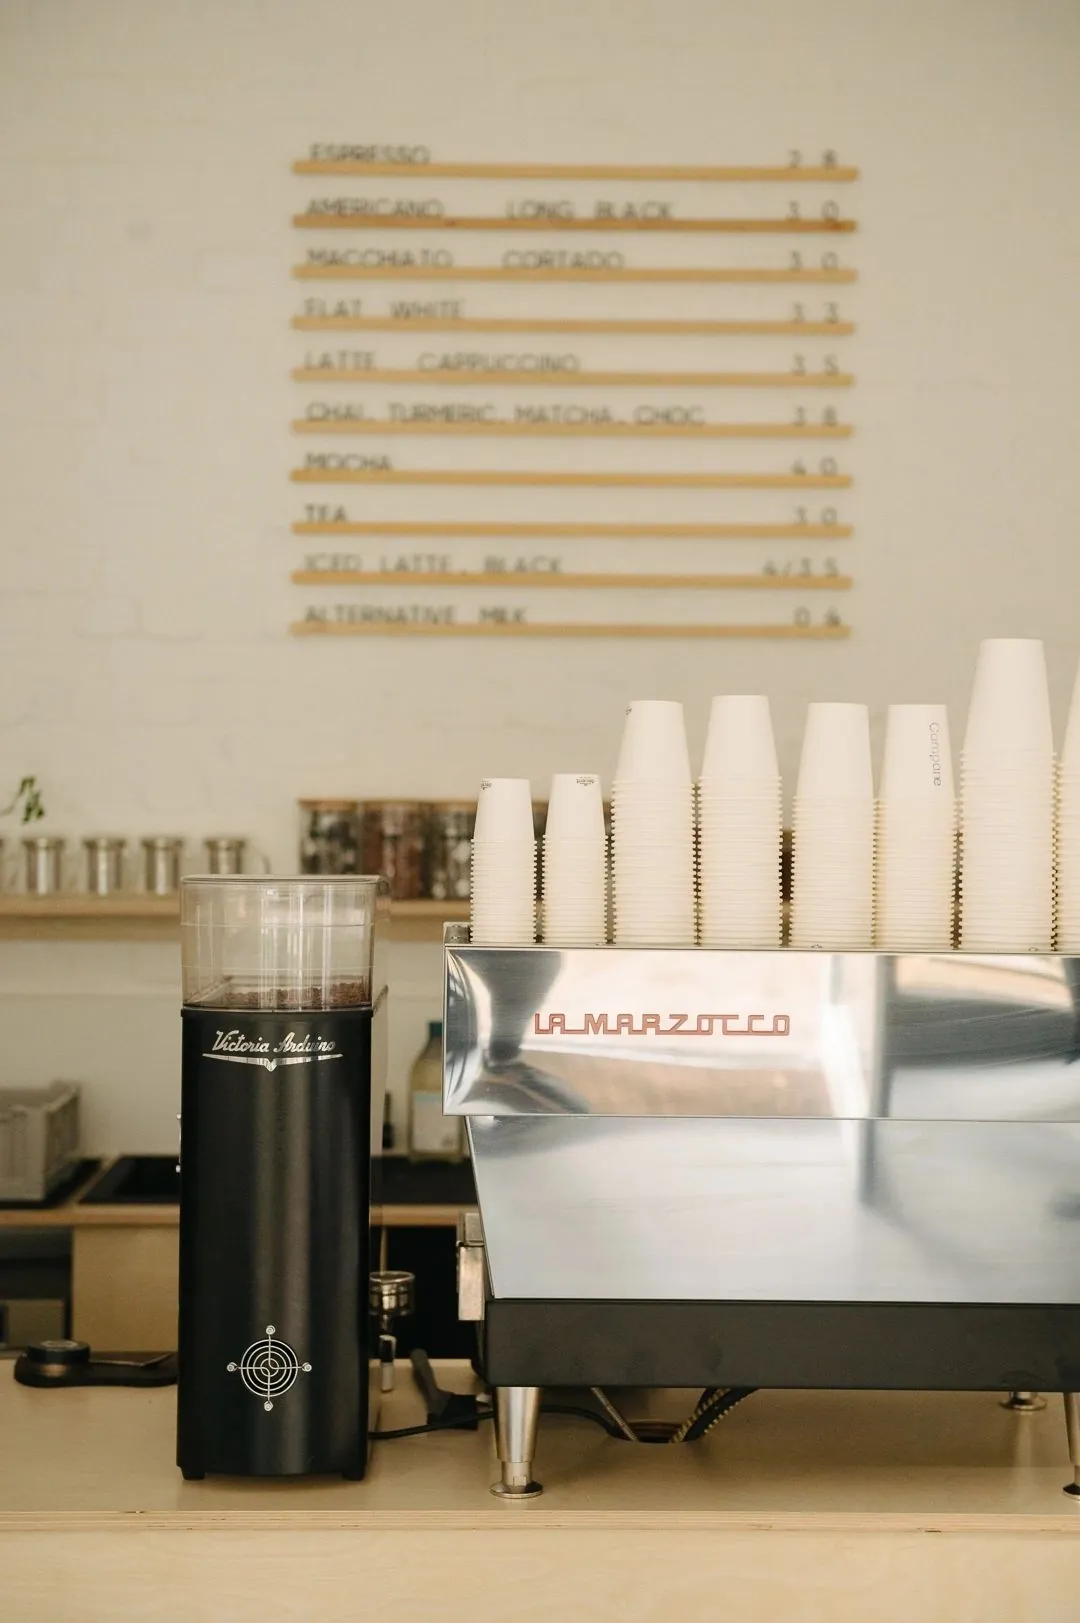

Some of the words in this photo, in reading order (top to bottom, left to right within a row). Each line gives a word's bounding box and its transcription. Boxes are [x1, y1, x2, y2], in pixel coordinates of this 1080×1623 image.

[310, 144, 430, 164] ESPRESSO
[306, 198, 445, 217] AMERICANO
[505, 200, 574, 220] LONG
[594, 202, 673, 221] BLACK
[306, 249, 453, 268] MACCHIATO
[502, 251, 624, 270] CORTADO
[305, 298, 362, 318] FLAT
[390, 300, 464, 319] WHITE
[304, 350, 376, 370] LATTE
[416, 352, 580, 372] CAPPUCCINO
[634, 406, 704, 425] CHOC
[304, 453, 394, 471] MOCHA
[304, 503, 348, 522] TEA
[304, 554, 362, 572] ICED
[484, 556, 561, 574] BLACK
[304, 605, 456, 624] ALTERNATIVE
[478, 606, 527, 624] MILK
[535, 1013, 566, 1035] LA
[212, 1030, 269, 1053] Victoria
[273, 1031, 337, 1053] Arduino
